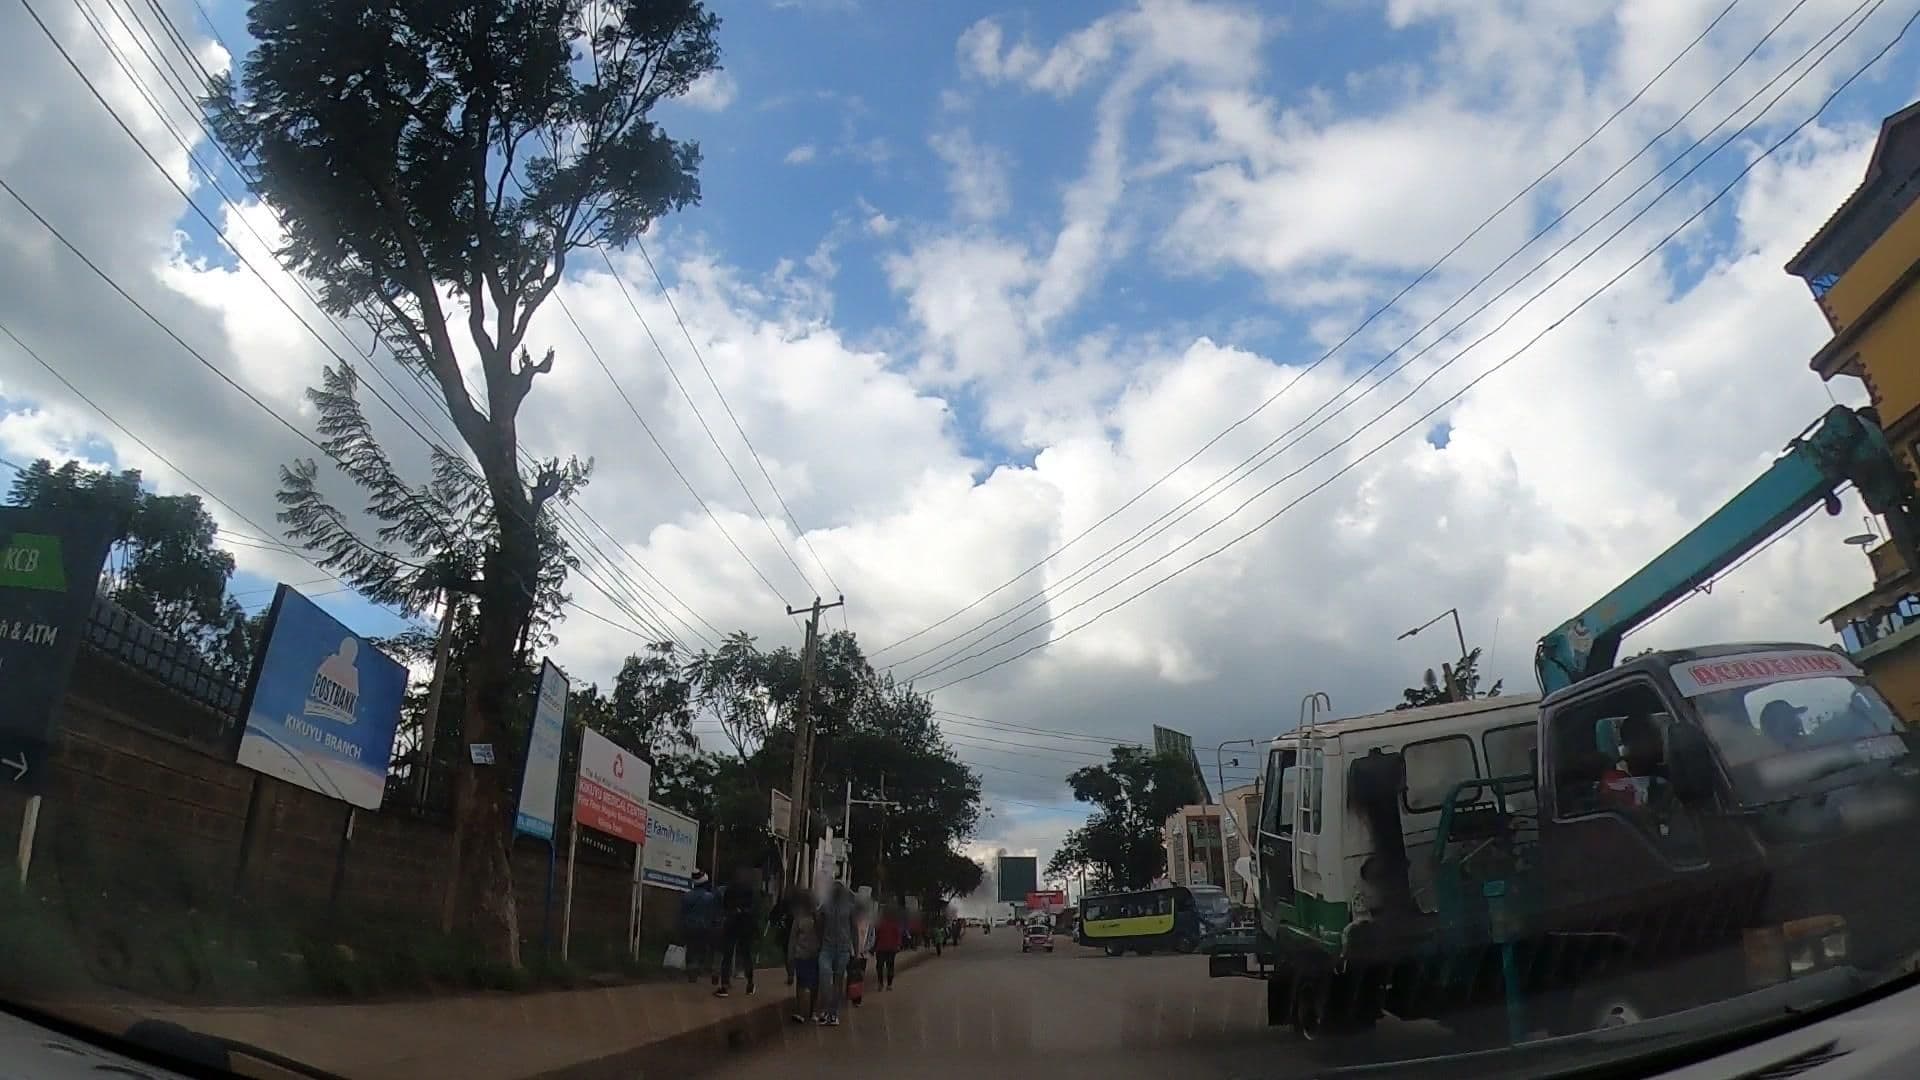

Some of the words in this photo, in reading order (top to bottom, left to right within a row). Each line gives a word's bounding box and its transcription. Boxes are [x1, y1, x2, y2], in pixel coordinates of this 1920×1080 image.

[4, 547, 40, 572] KCB
[11, 621, 21, 640] &
[24, 623, 58, 647] ATM
[313, 672, 357, 715] POSTBANK
[284, 713, 322, 742] KIKUYU
[324, 733, 362, 759] BRANCH
[653, 820, 675, 842] Family
